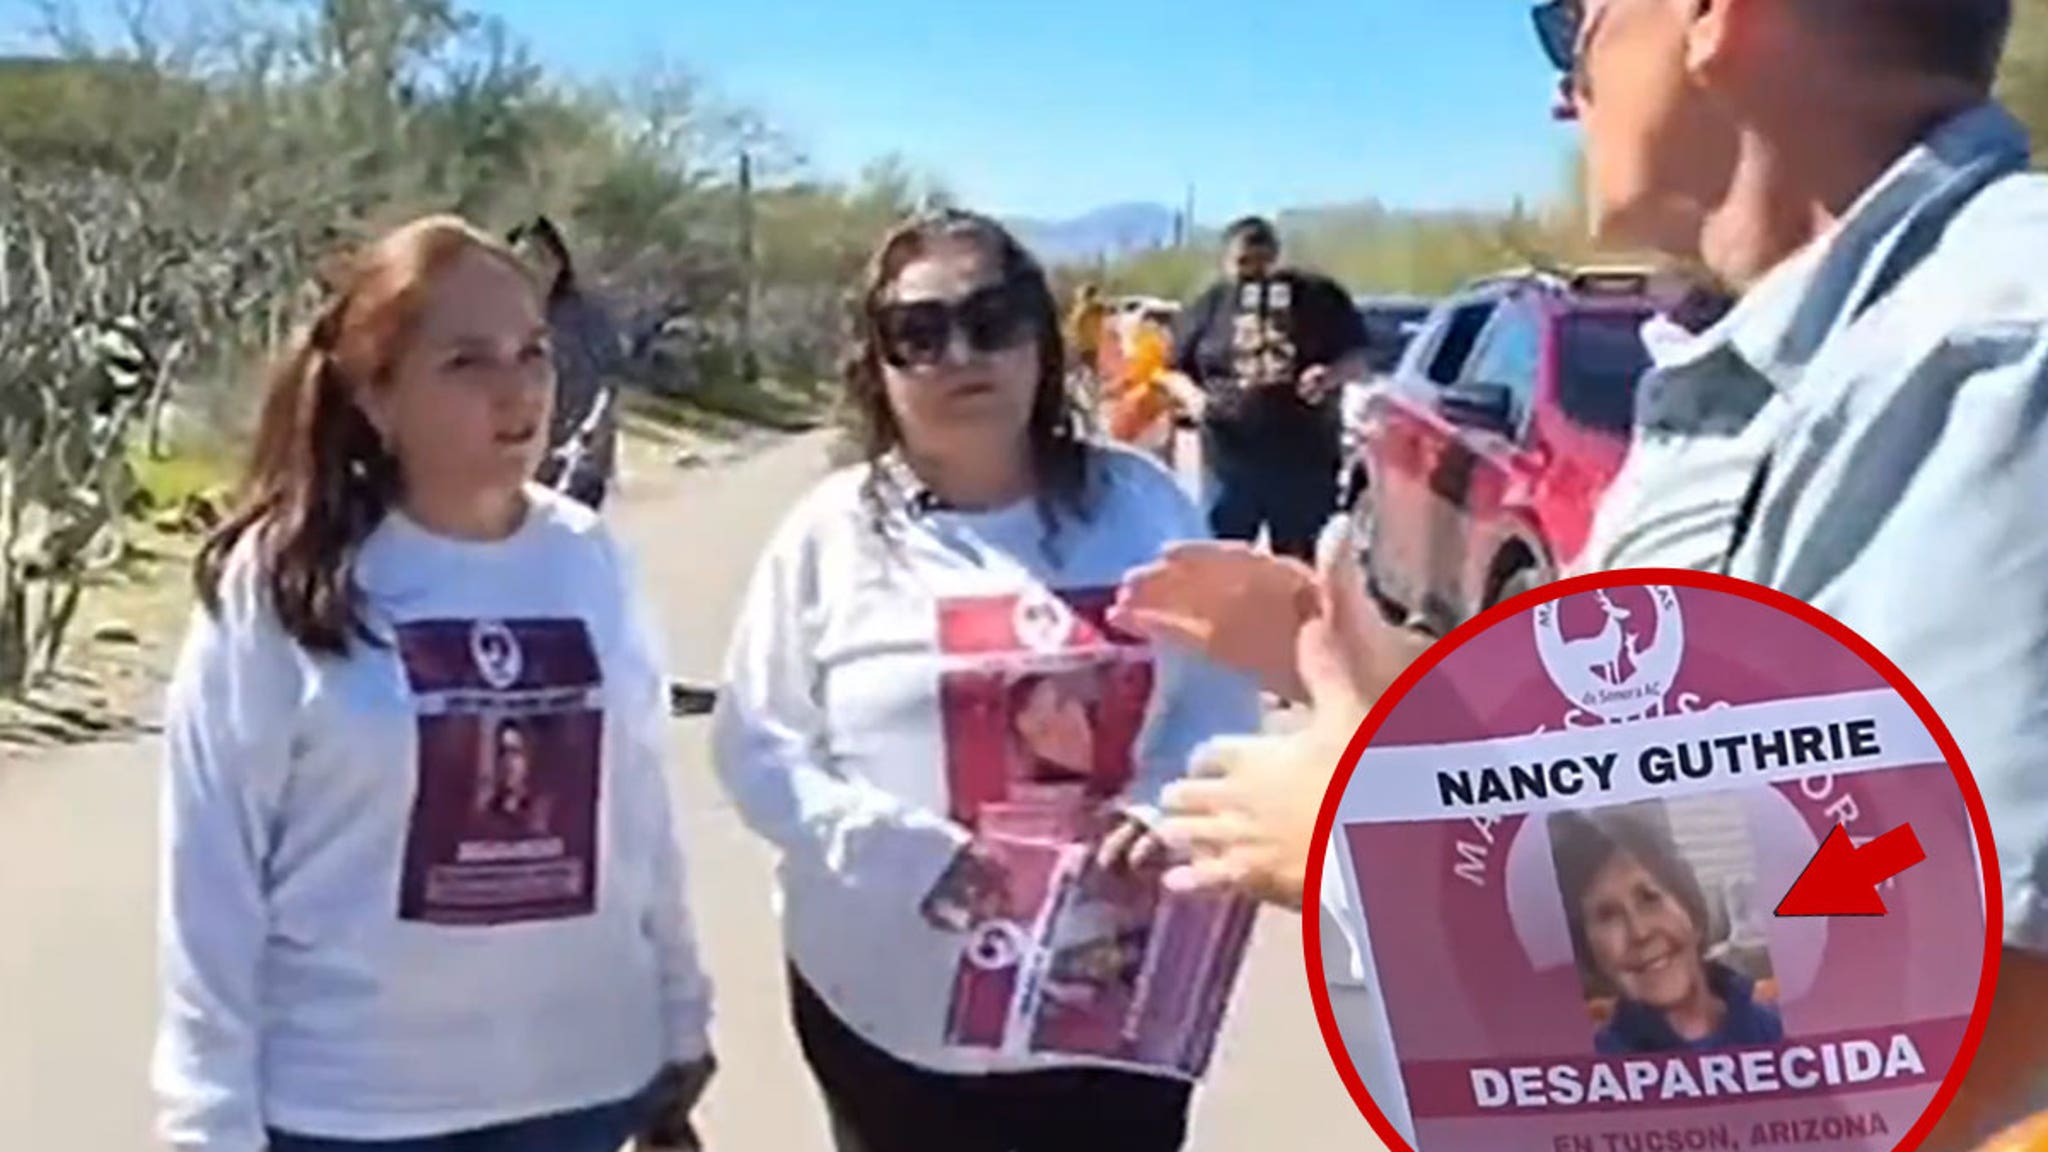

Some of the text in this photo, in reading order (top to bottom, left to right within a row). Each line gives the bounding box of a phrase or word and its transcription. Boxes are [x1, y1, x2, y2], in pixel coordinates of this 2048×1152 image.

[1437, 719, 1881, 807] NANCY GUTHRIE
[1469, 1034, 1925, 1108] DESAPARECIDA
[1601, 1122, 1740, 1152] TUCSON,
[1750, 1110, 1889, 1146] ARIZONA
